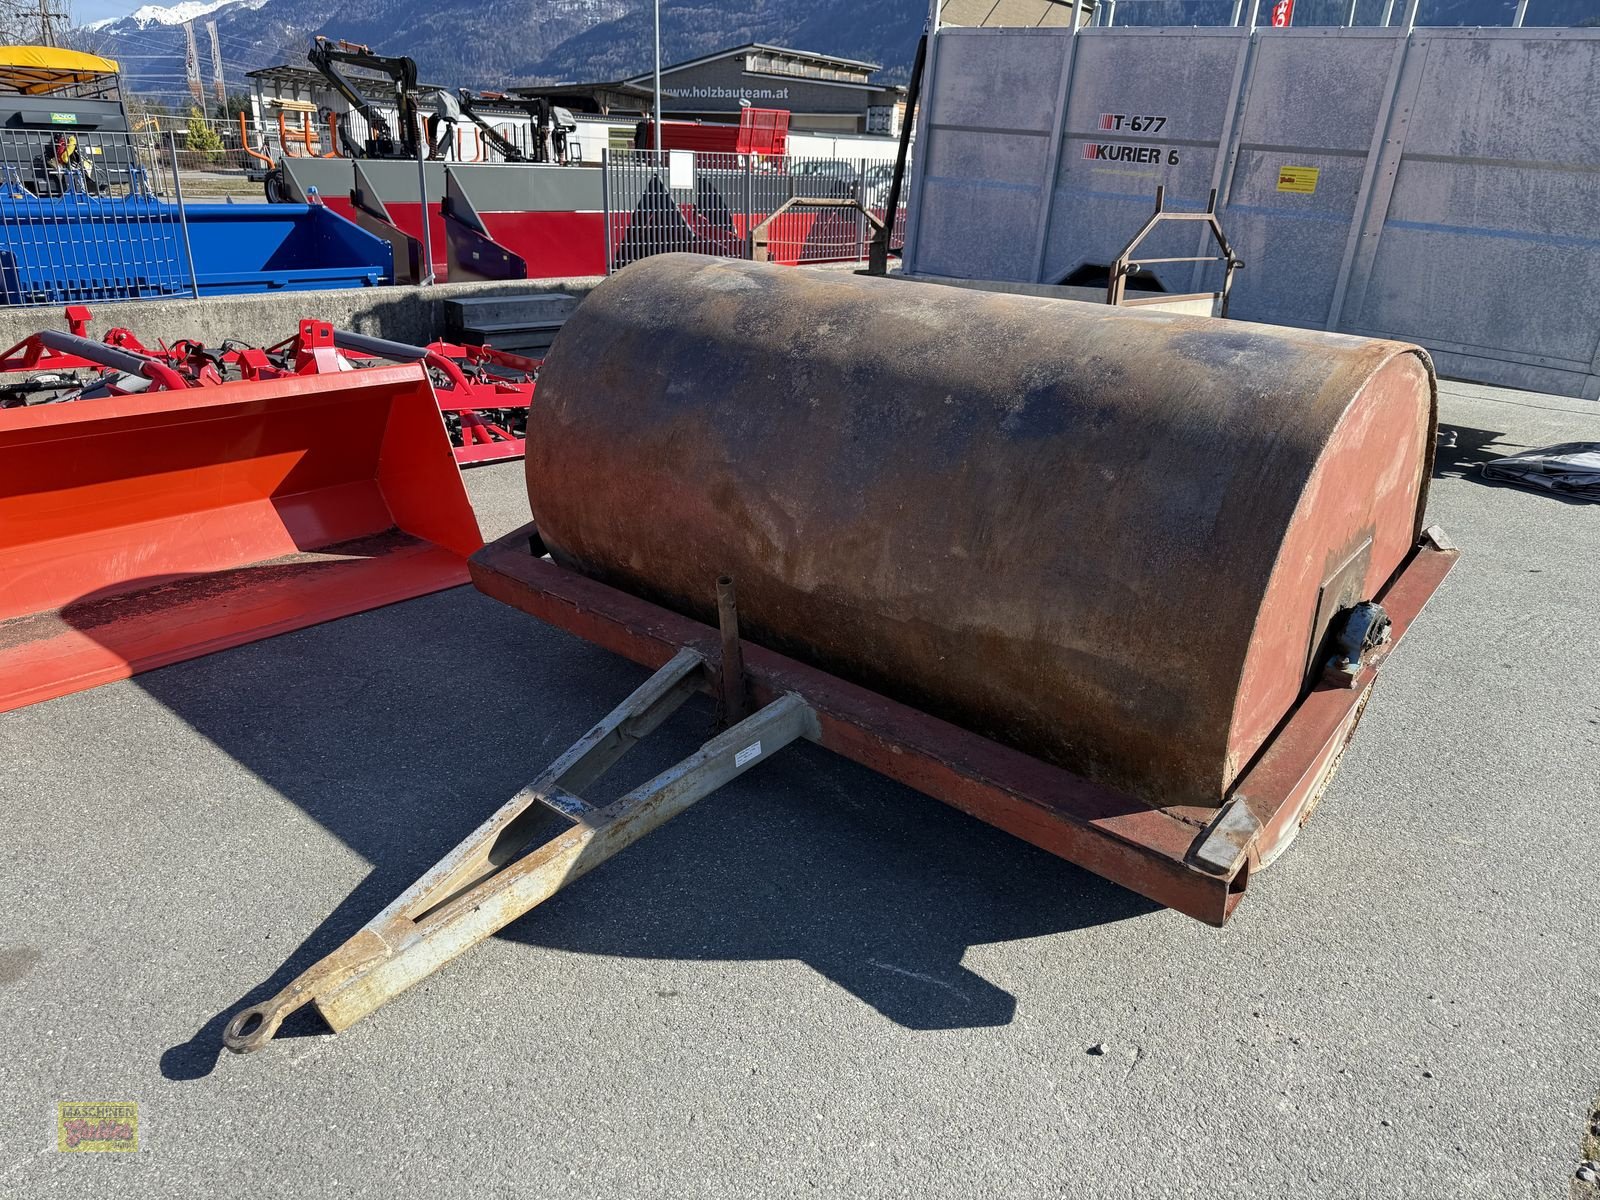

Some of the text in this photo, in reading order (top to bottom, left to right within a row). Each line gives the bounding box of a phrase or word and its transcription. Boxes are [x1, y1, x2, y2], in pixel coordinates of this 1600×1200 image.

[1113, 114, 1167, 133] T-677
[1095, 144, 1180, 165] KURIER 6
